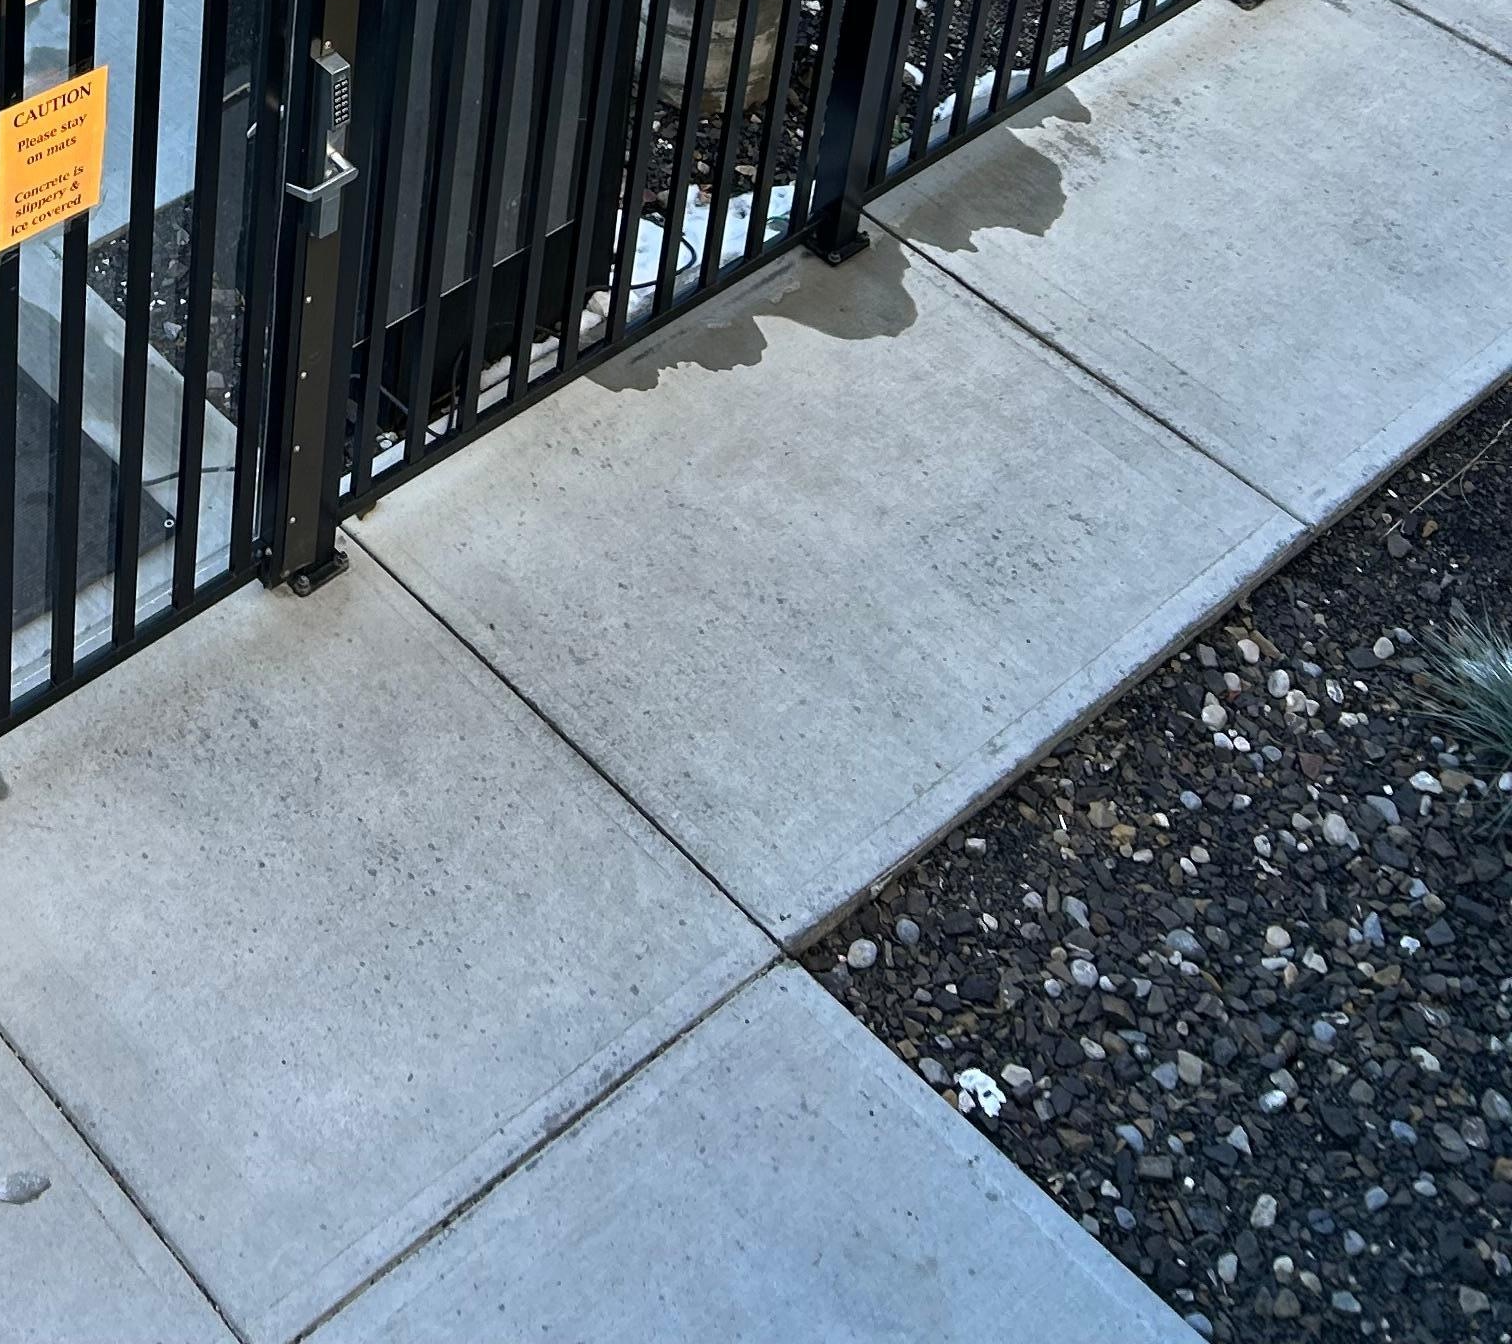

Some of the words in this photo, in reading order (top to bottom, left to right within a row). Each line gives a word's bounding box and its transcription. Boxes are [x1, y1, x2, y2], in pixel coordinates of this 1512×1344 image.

[13, 82, 92, 128] CAUTION
[17, 126, 58, 153] Please
[60, 113, 87, 134] stay
[26, 151, 43, 166] on
[46, 137, 77, 157] mats
[14, 170, 70, 205] Concrete
[73, 165, 84, 177] is
[15, 188, 67, 219] slippery
[69, 180, 81, 191] &
[31, 194, 83, 226] covered
